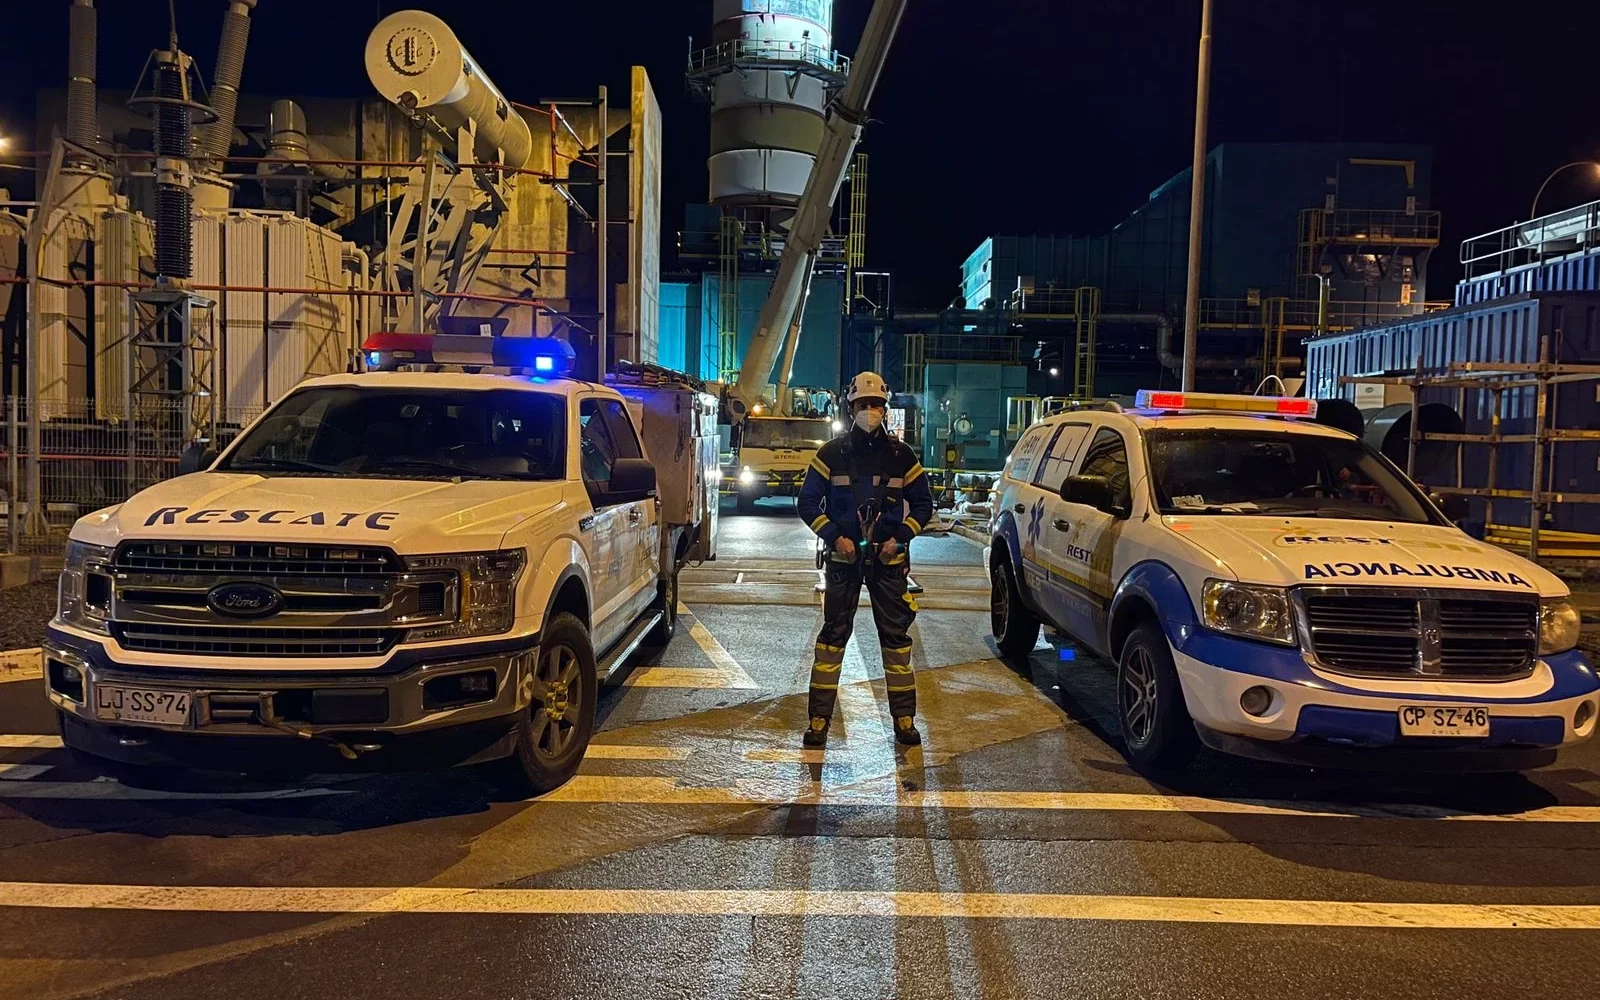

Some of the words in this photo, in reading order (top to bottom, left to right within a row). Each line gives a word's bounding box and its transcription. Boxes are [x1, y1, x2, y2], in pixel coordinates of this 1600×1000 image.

[143, 507, 400, 531] RESCATE
[1066, 544, 1092, 562] REST
[225, 594, 260, 608] Ford
